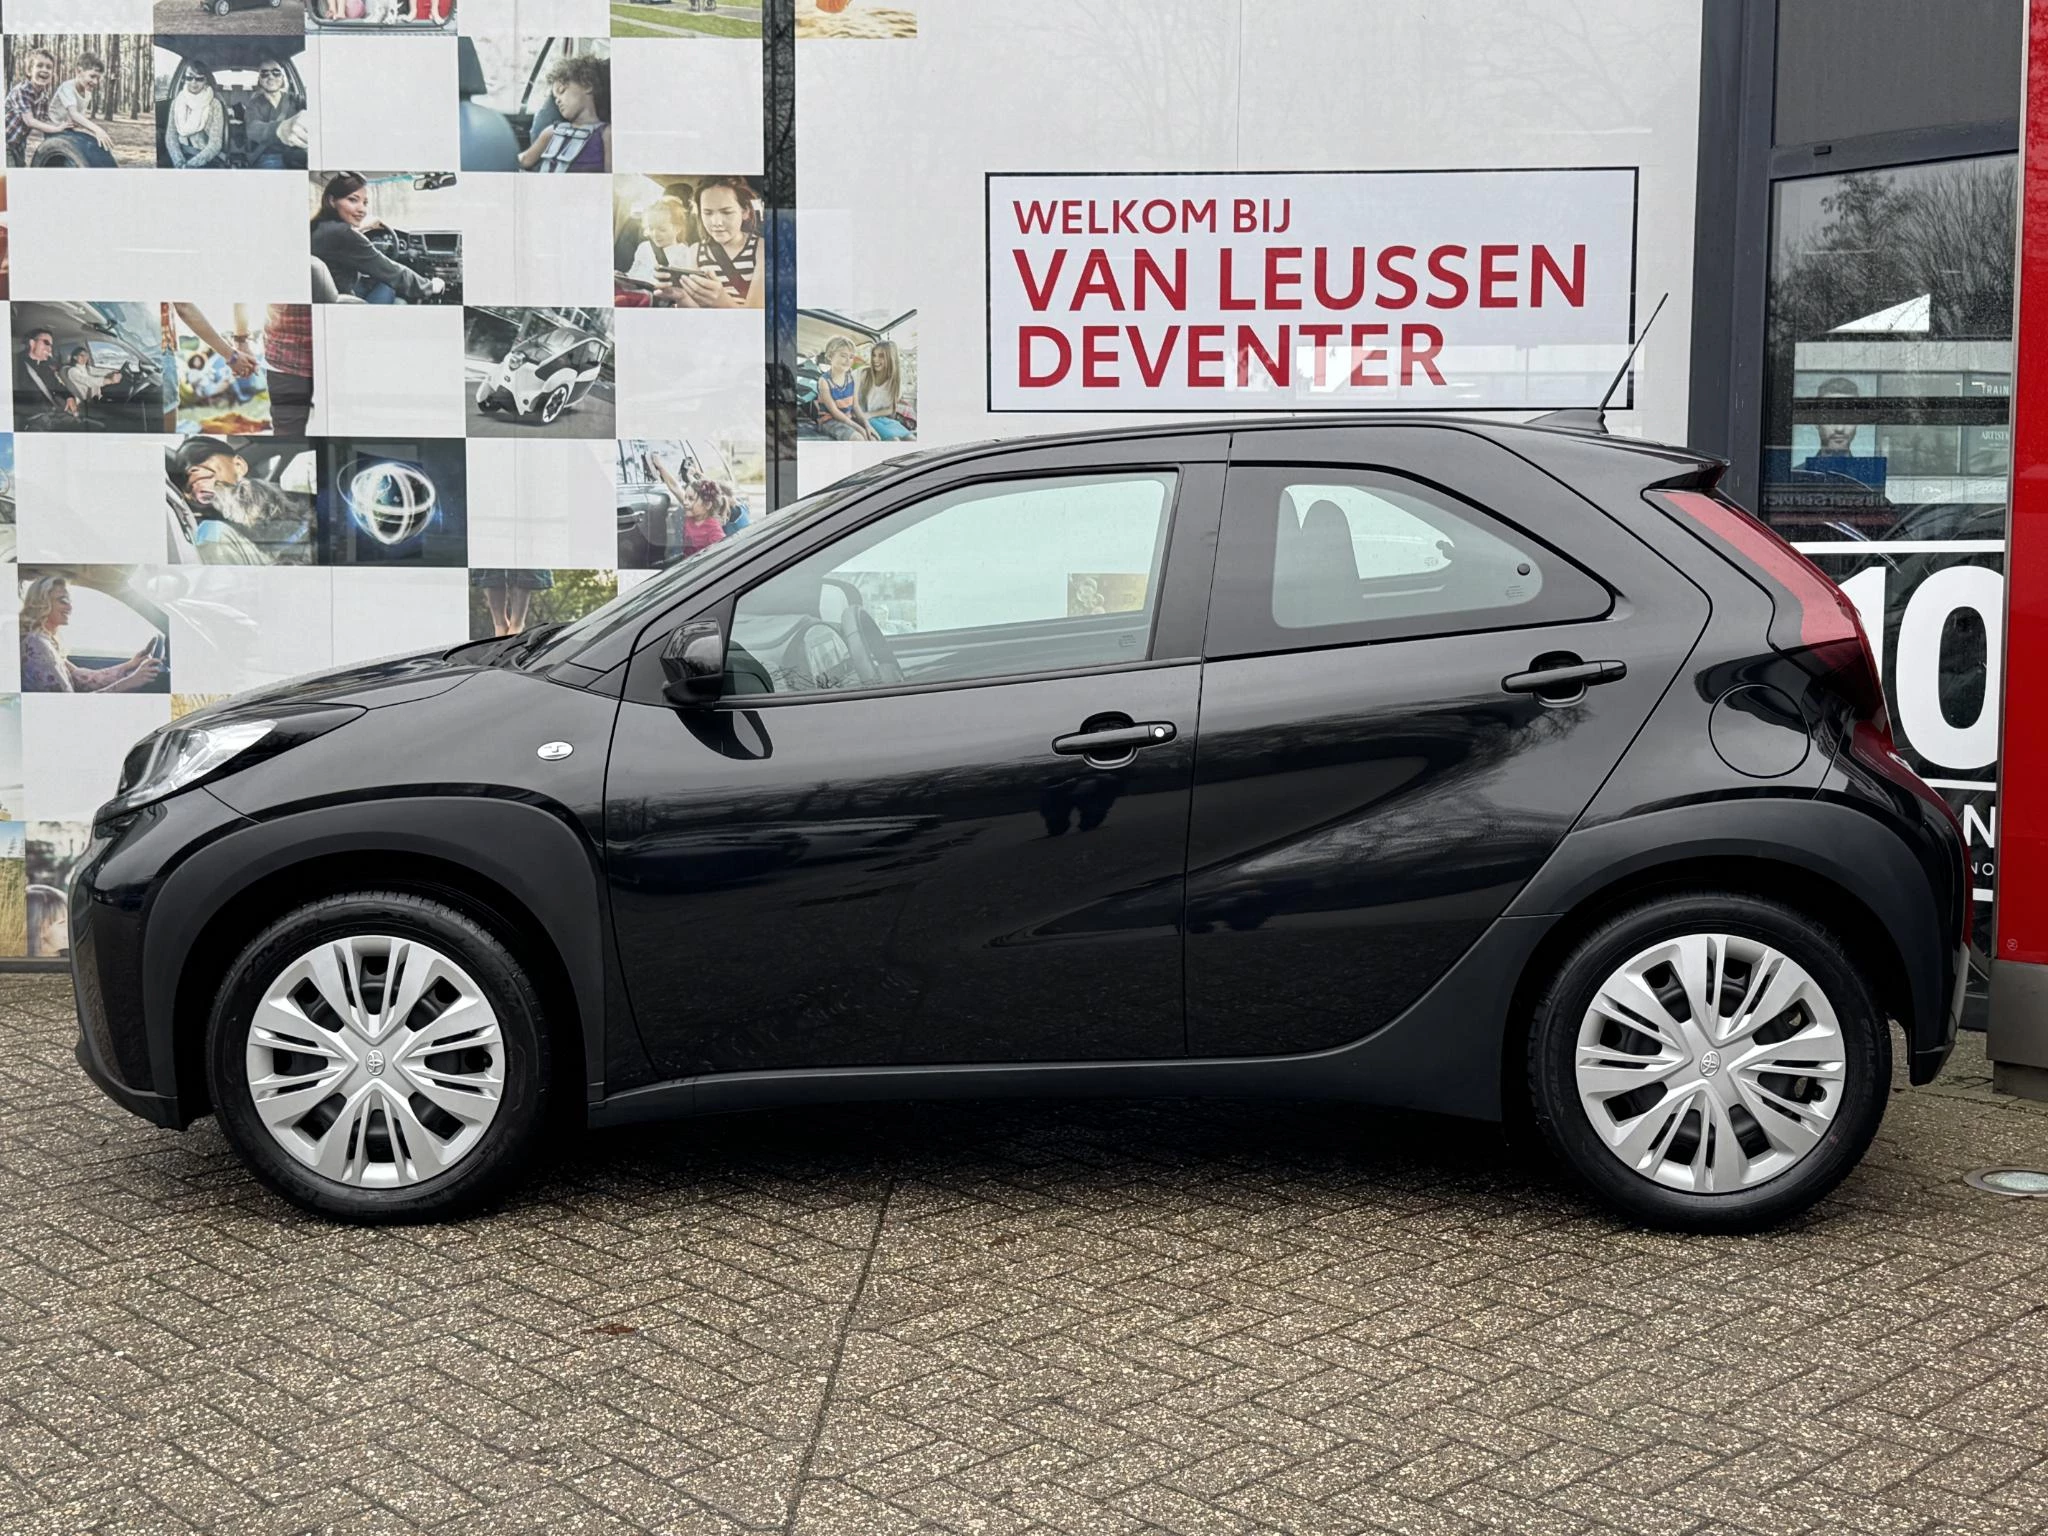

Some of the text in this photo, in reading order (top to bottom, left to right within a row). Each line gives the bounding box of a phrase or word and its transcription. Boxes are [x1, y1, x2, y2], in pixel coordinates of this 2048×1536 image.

[1013, 198, 1291, 235] WELKOM BIJ
[1012, 243, 1586, 312] VAN LEUSSEN
[1018, 323, 1447, 388] DEVENTER
